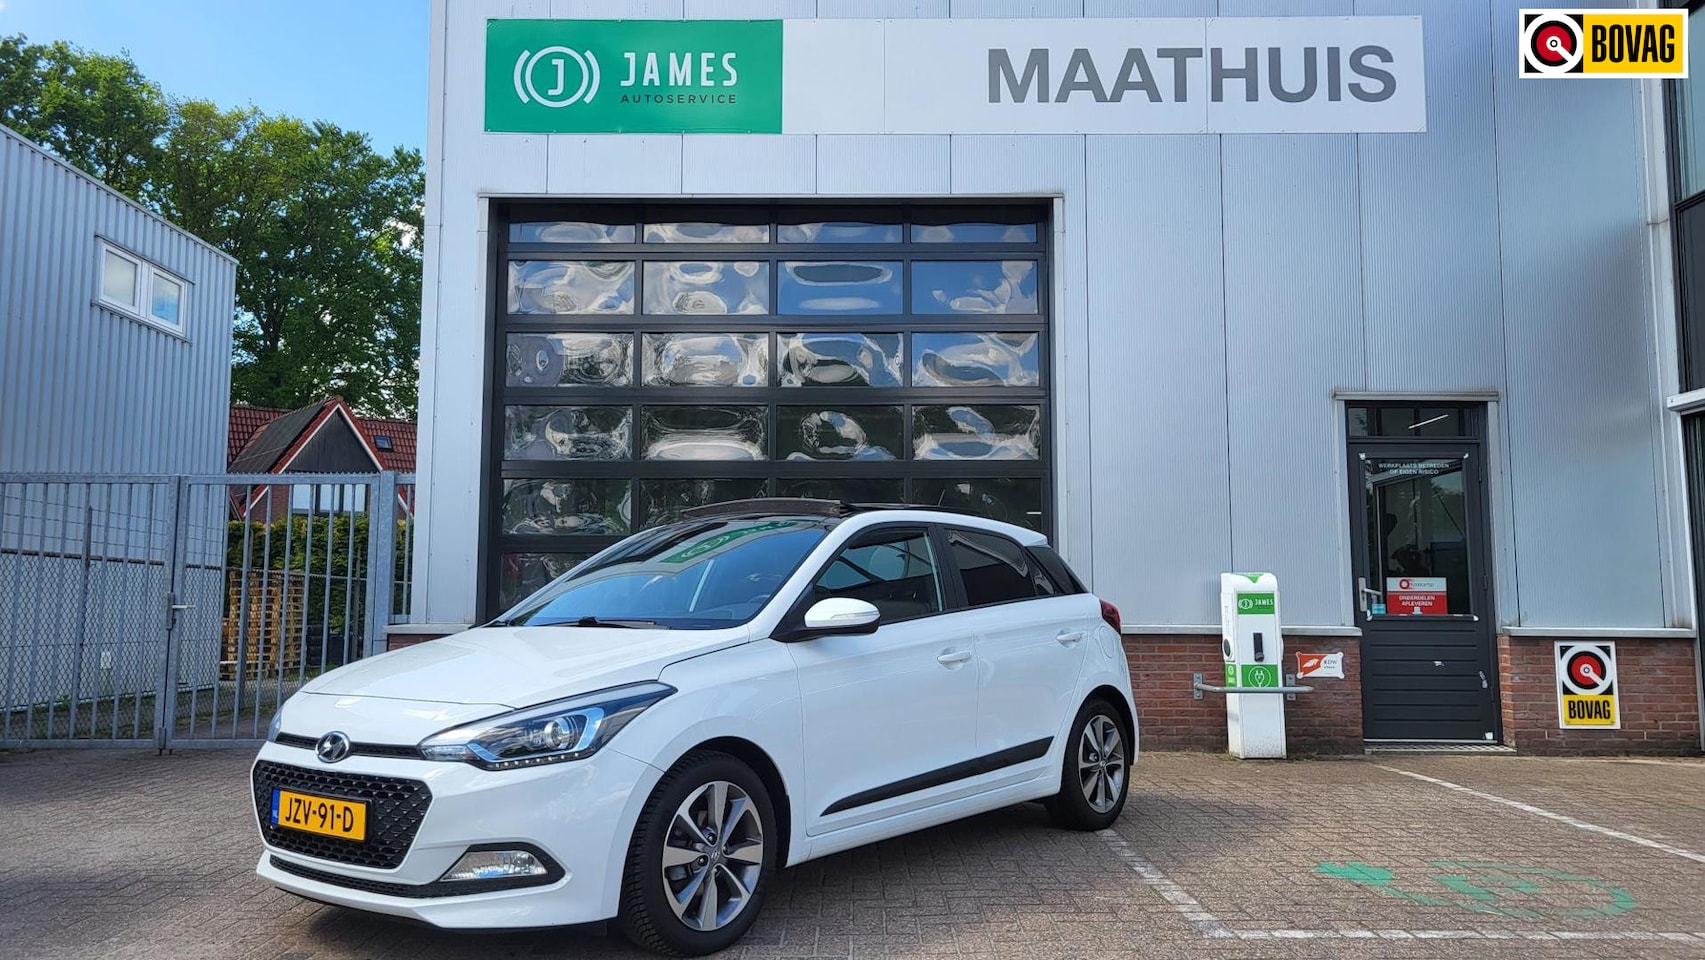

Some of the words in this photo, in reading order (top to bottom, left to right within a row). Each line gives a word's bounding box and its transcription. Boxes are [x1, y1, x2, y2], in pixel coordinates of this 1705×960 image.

[620, 52, 738, 87] JAMES
[987, 45, 1397, 104] MAATHUIS
[620, 94, 737, 104] AUTOSERVICE
[1568, 700, 1611, 720] BOVAG
[285, 797, 354, 832] JZV-91-D
